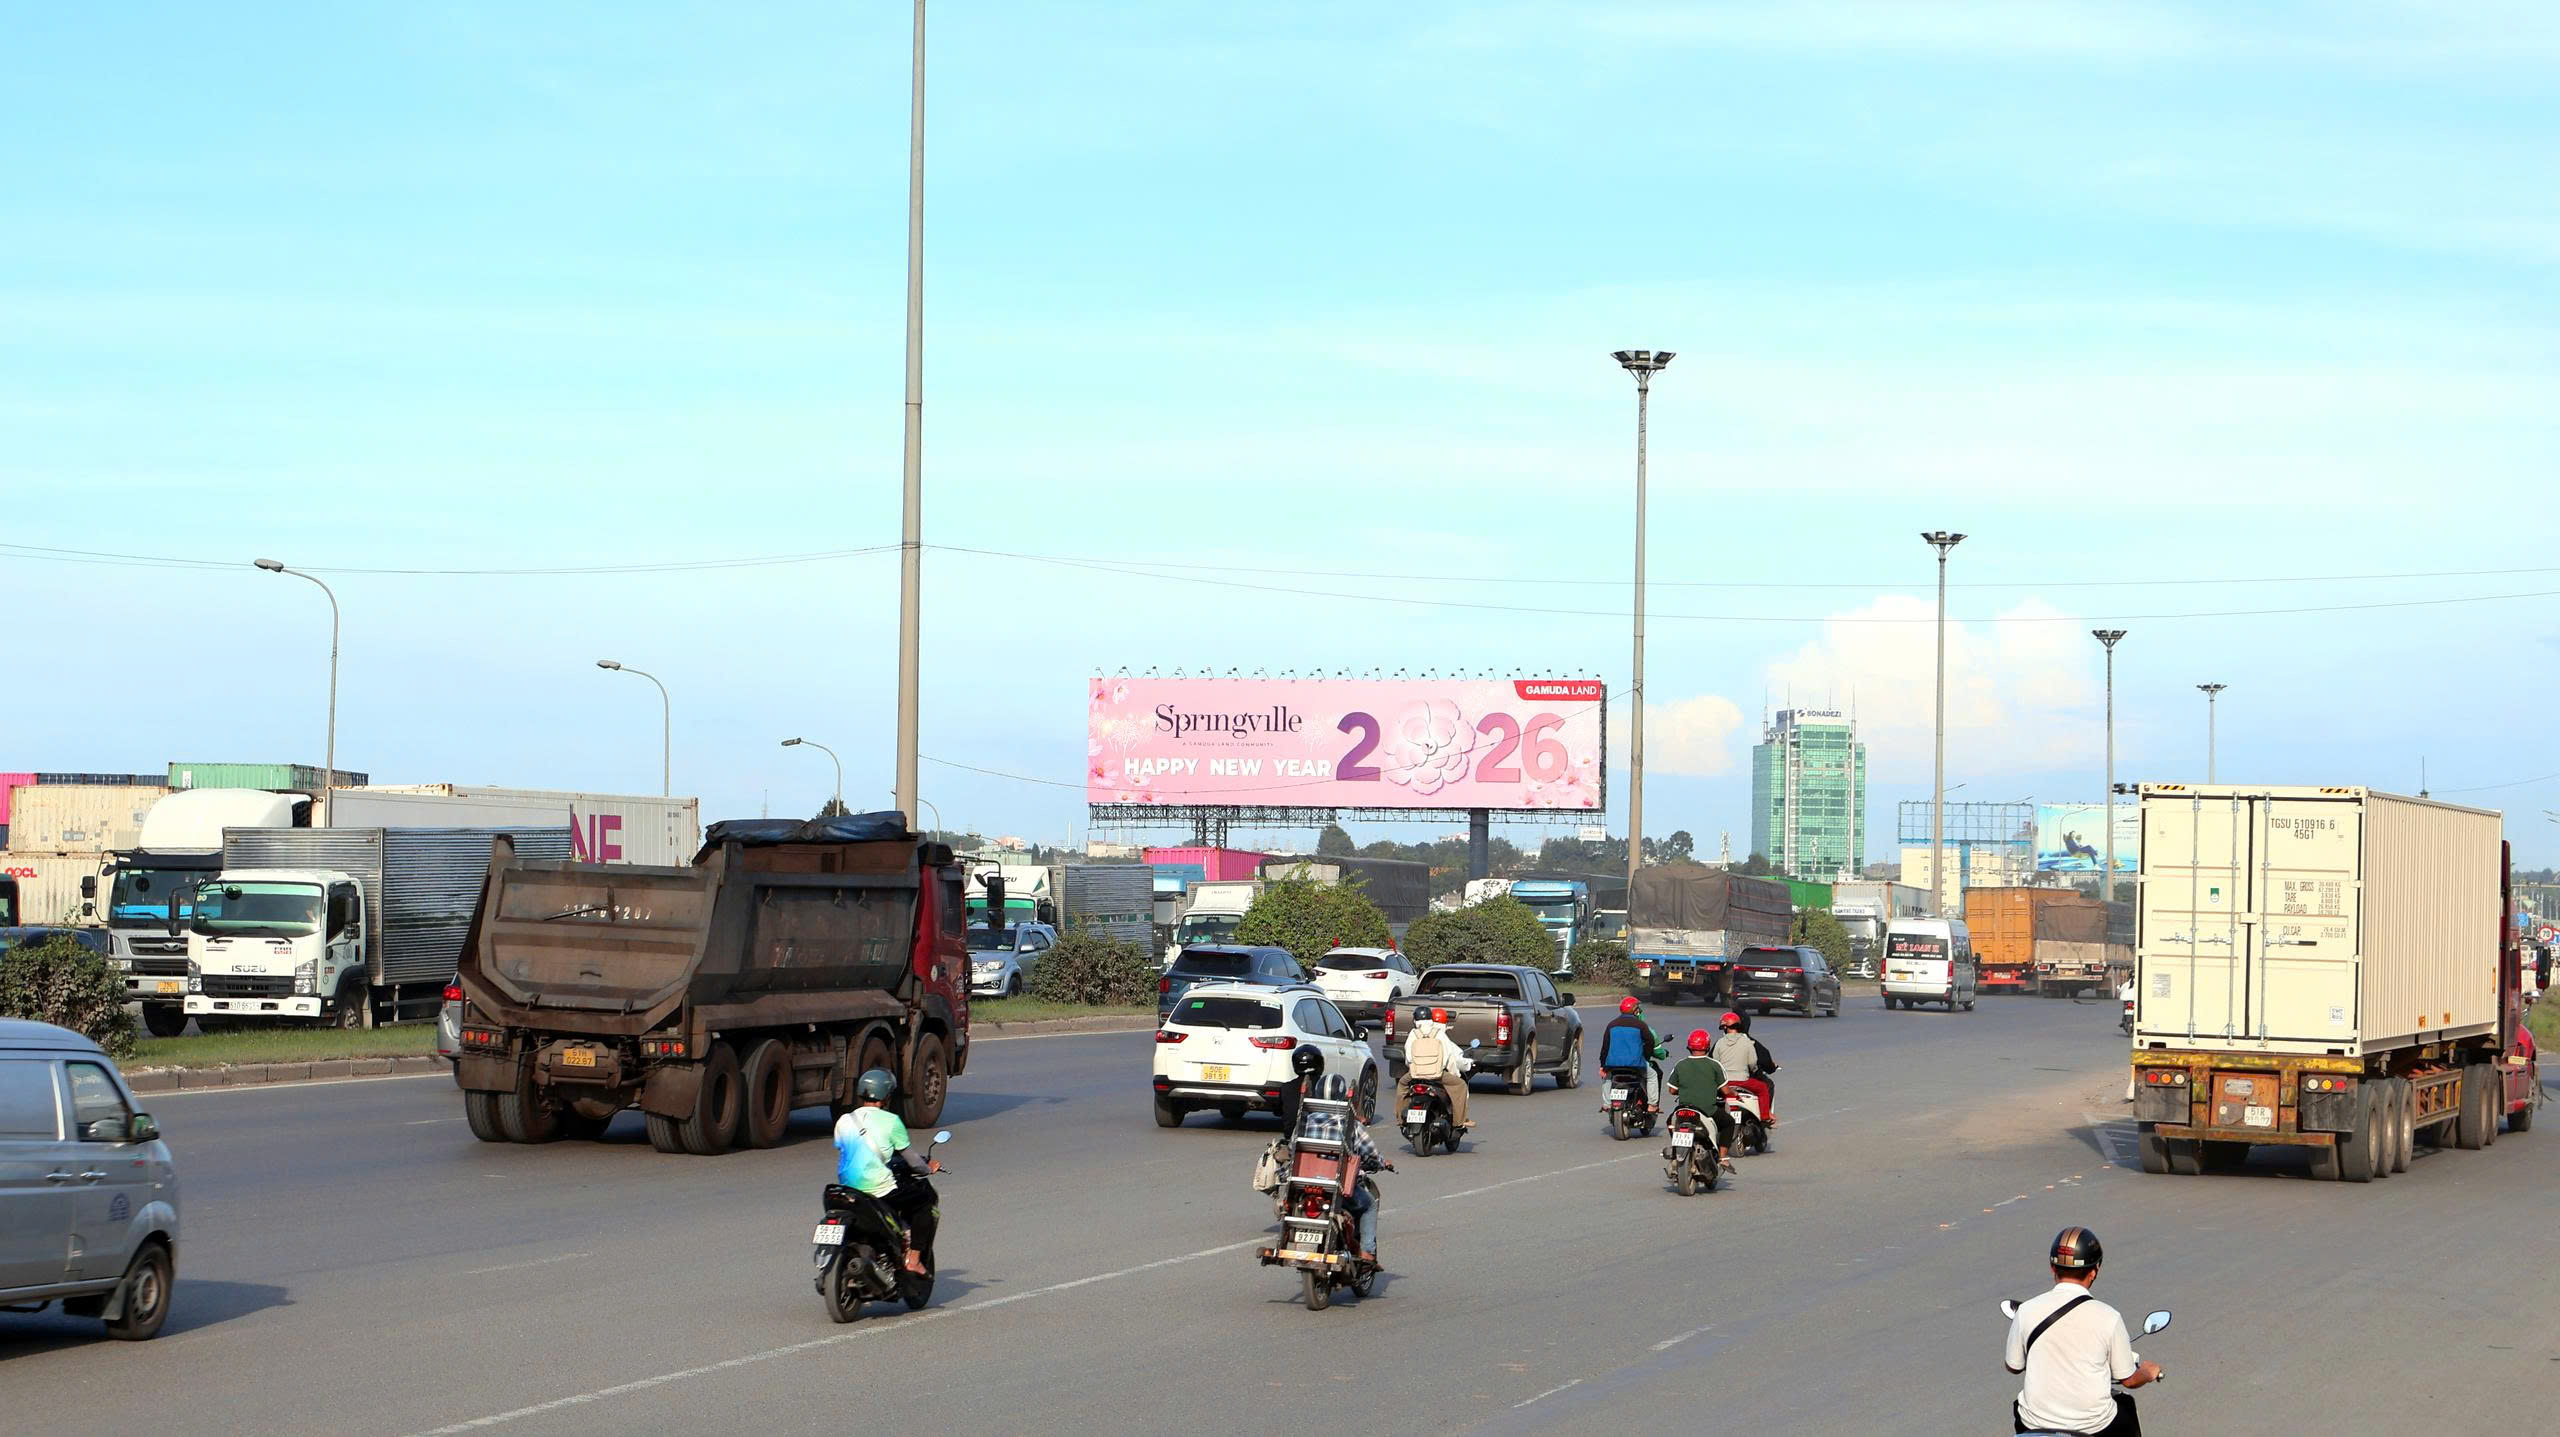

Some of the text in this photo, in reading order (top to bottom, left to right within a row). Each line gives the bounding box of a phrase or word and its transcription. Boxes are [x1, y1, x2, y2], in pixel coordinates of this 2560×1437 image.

[1525, 685, 1597, 695] GAMUDA LAND
[1807, 710, 1842, 718] SONADEZI
[1155, 704, 1302, 739] Springville
[1124, 757, 1333, 778] HAPPY NEW YEAR
[2270, 818, 2291, 828] TGSU
[2294, 819, 2325, 829] 510916
[570, 813, 622, 865] NE
[2294, 829, 2314, 840] 45G1
[2284, 903, 2307, 914] PAYLOAD
[231, 965, 267, 973] ISUZU
[1297, 1233, 1320, 1242] 9270
